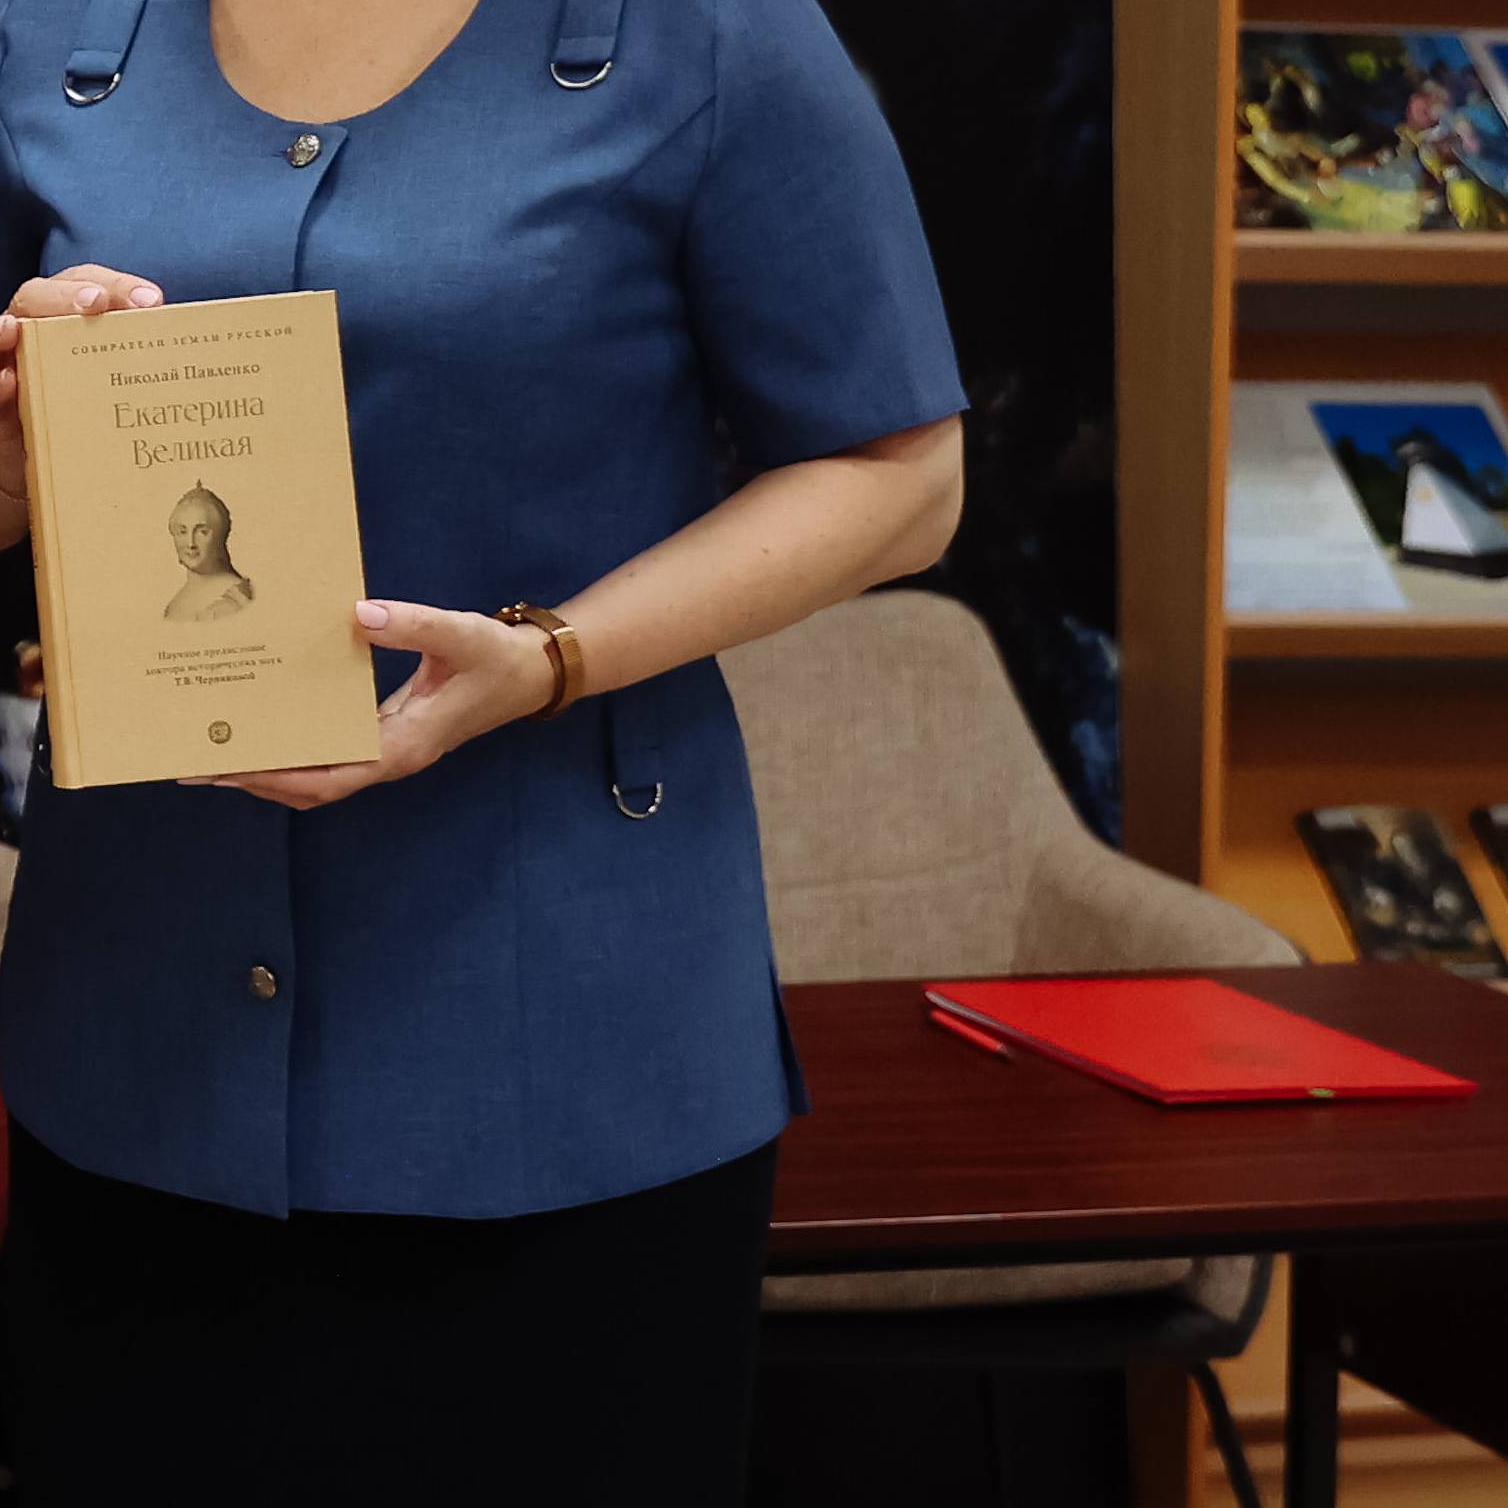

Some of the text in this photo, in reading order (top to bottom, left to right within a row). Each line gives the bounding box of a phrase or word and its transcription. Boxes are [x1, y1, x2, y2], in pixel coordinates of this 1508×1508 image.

[71, 325, 293, 356] СОБИРАТЕЛИ ЗЕМЛИ РУССКОЙ
[110, 363, 261, 387] Николай Павленко
[113, 396, 265, 429] Екатерина
[133, 434, 253, 469] Великая
